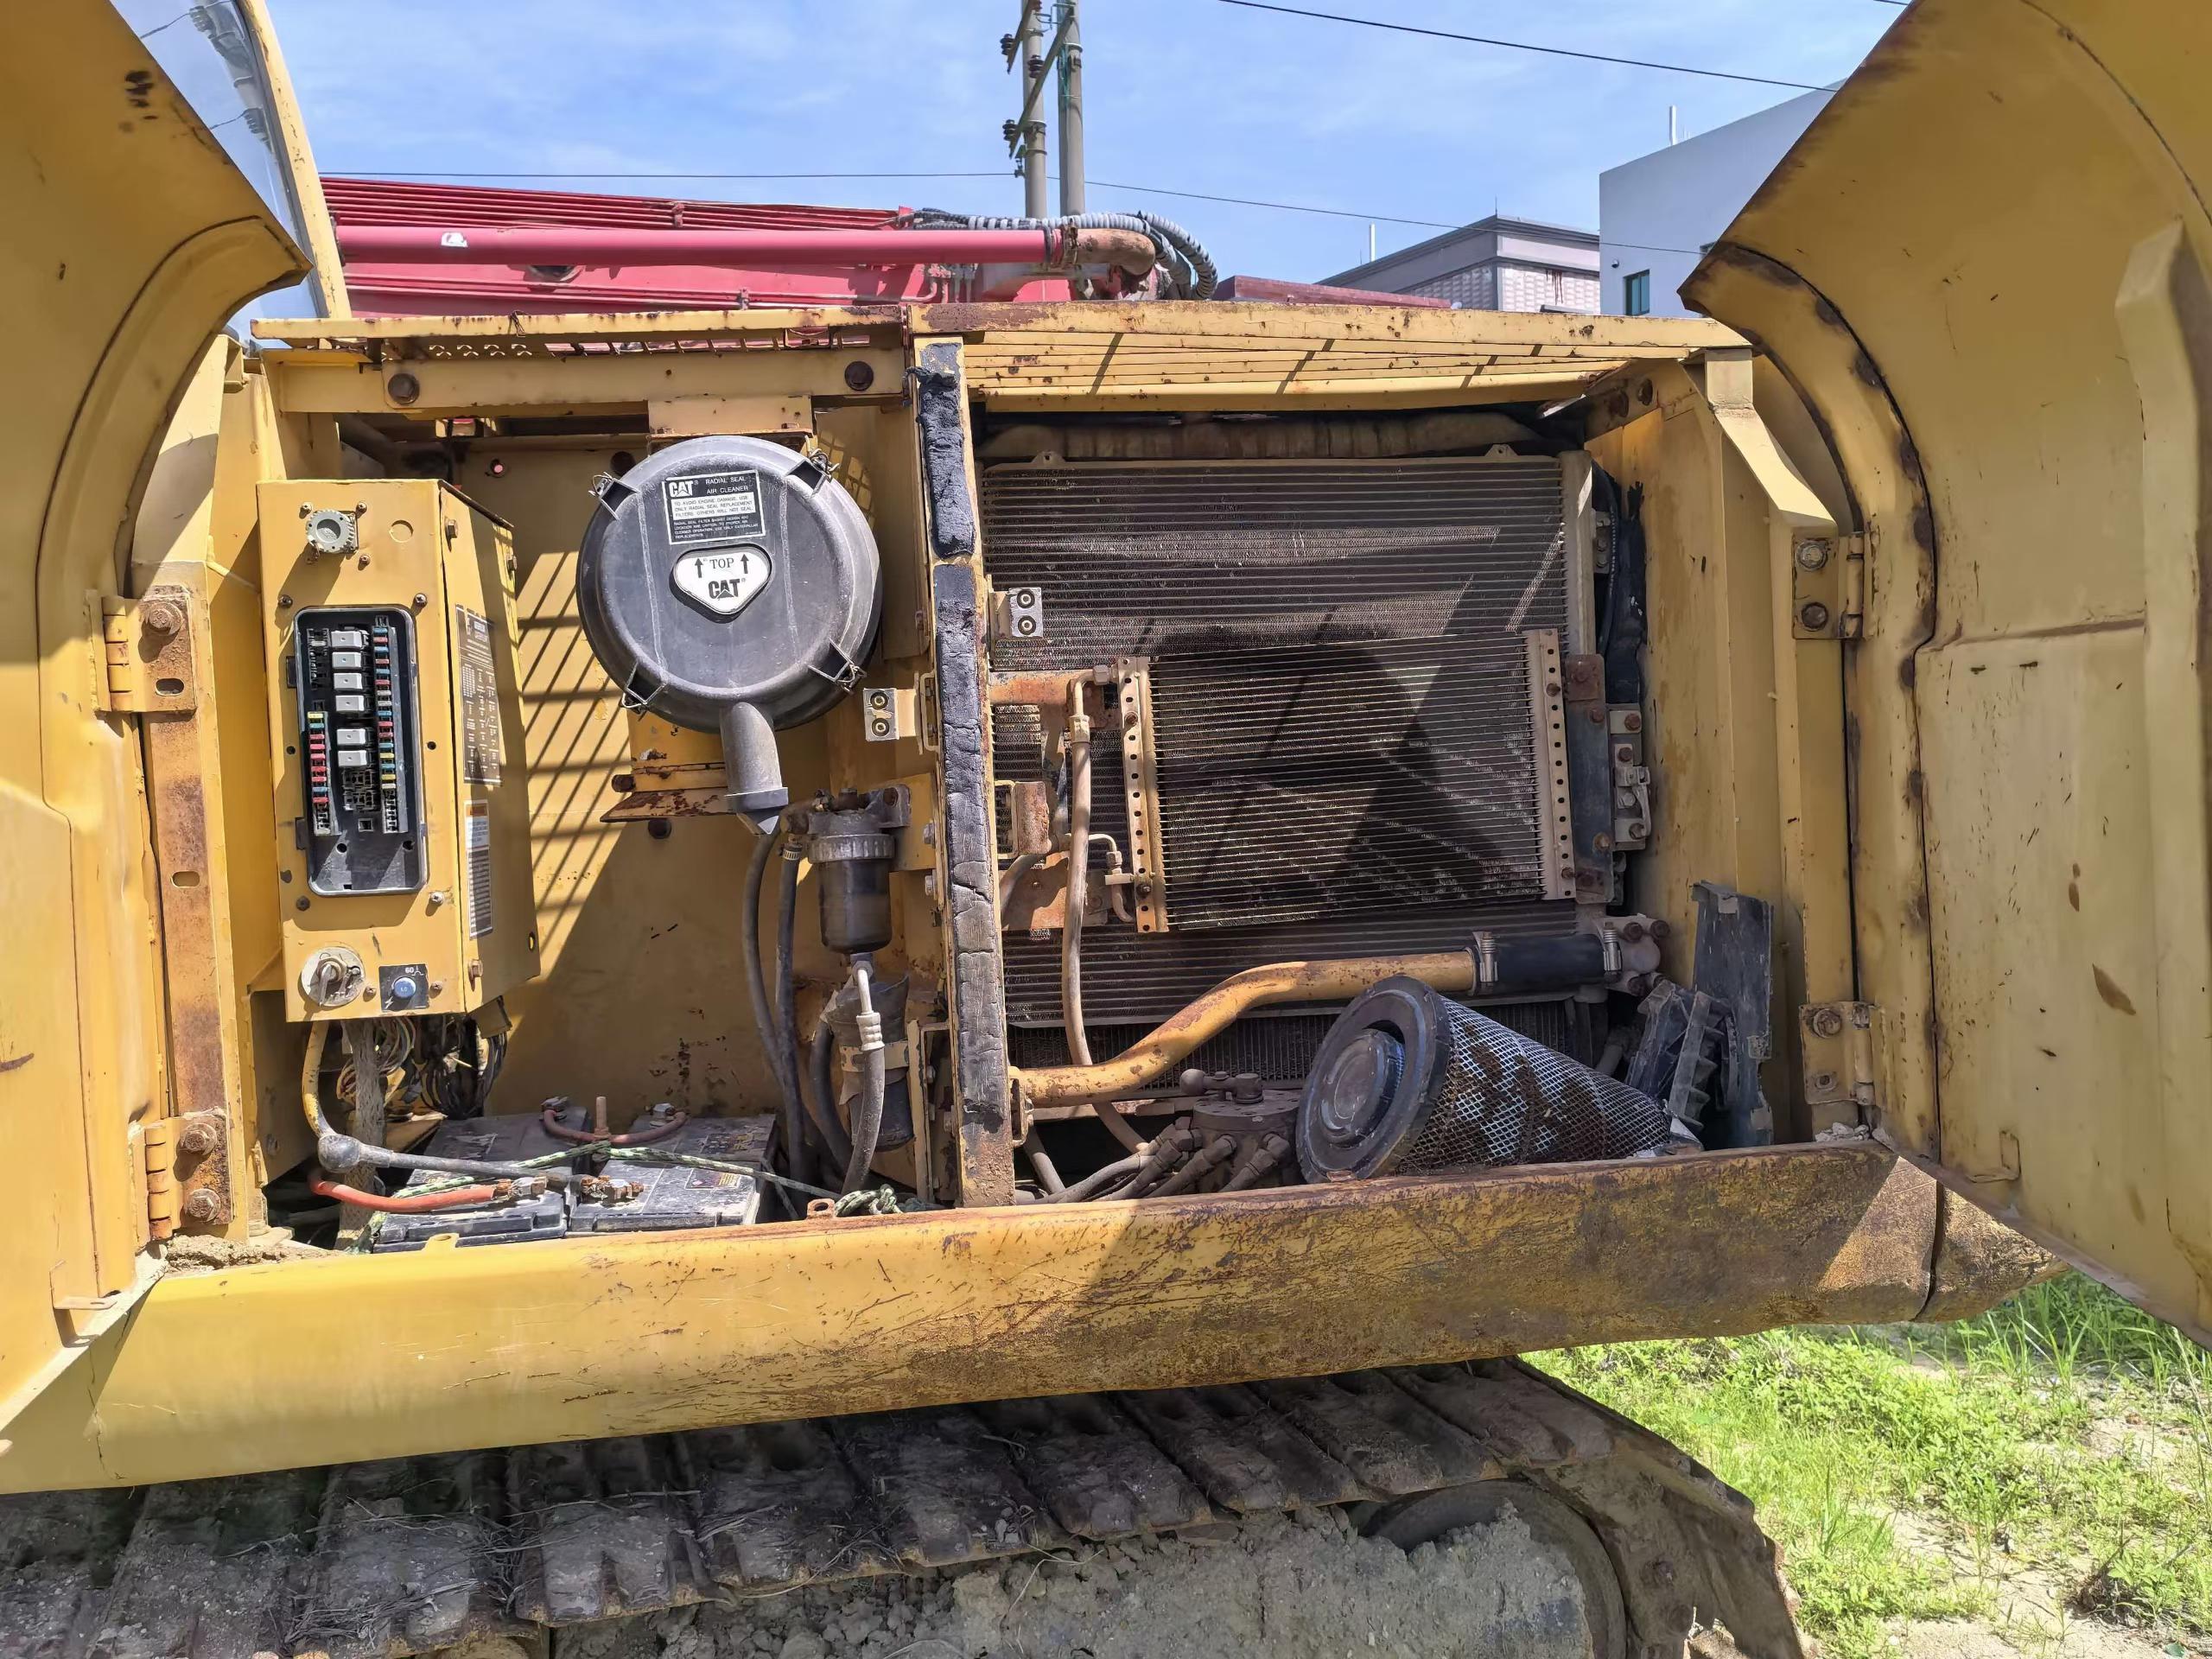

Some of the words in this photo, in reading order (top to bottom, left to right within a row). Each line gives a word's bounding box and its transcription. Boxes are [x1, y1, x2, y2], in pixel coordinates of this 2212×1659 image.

[669, 480, 693, 498] CAT
[709, 558, 734, 569] TOP
[708, 578, 741, 599] CAT
